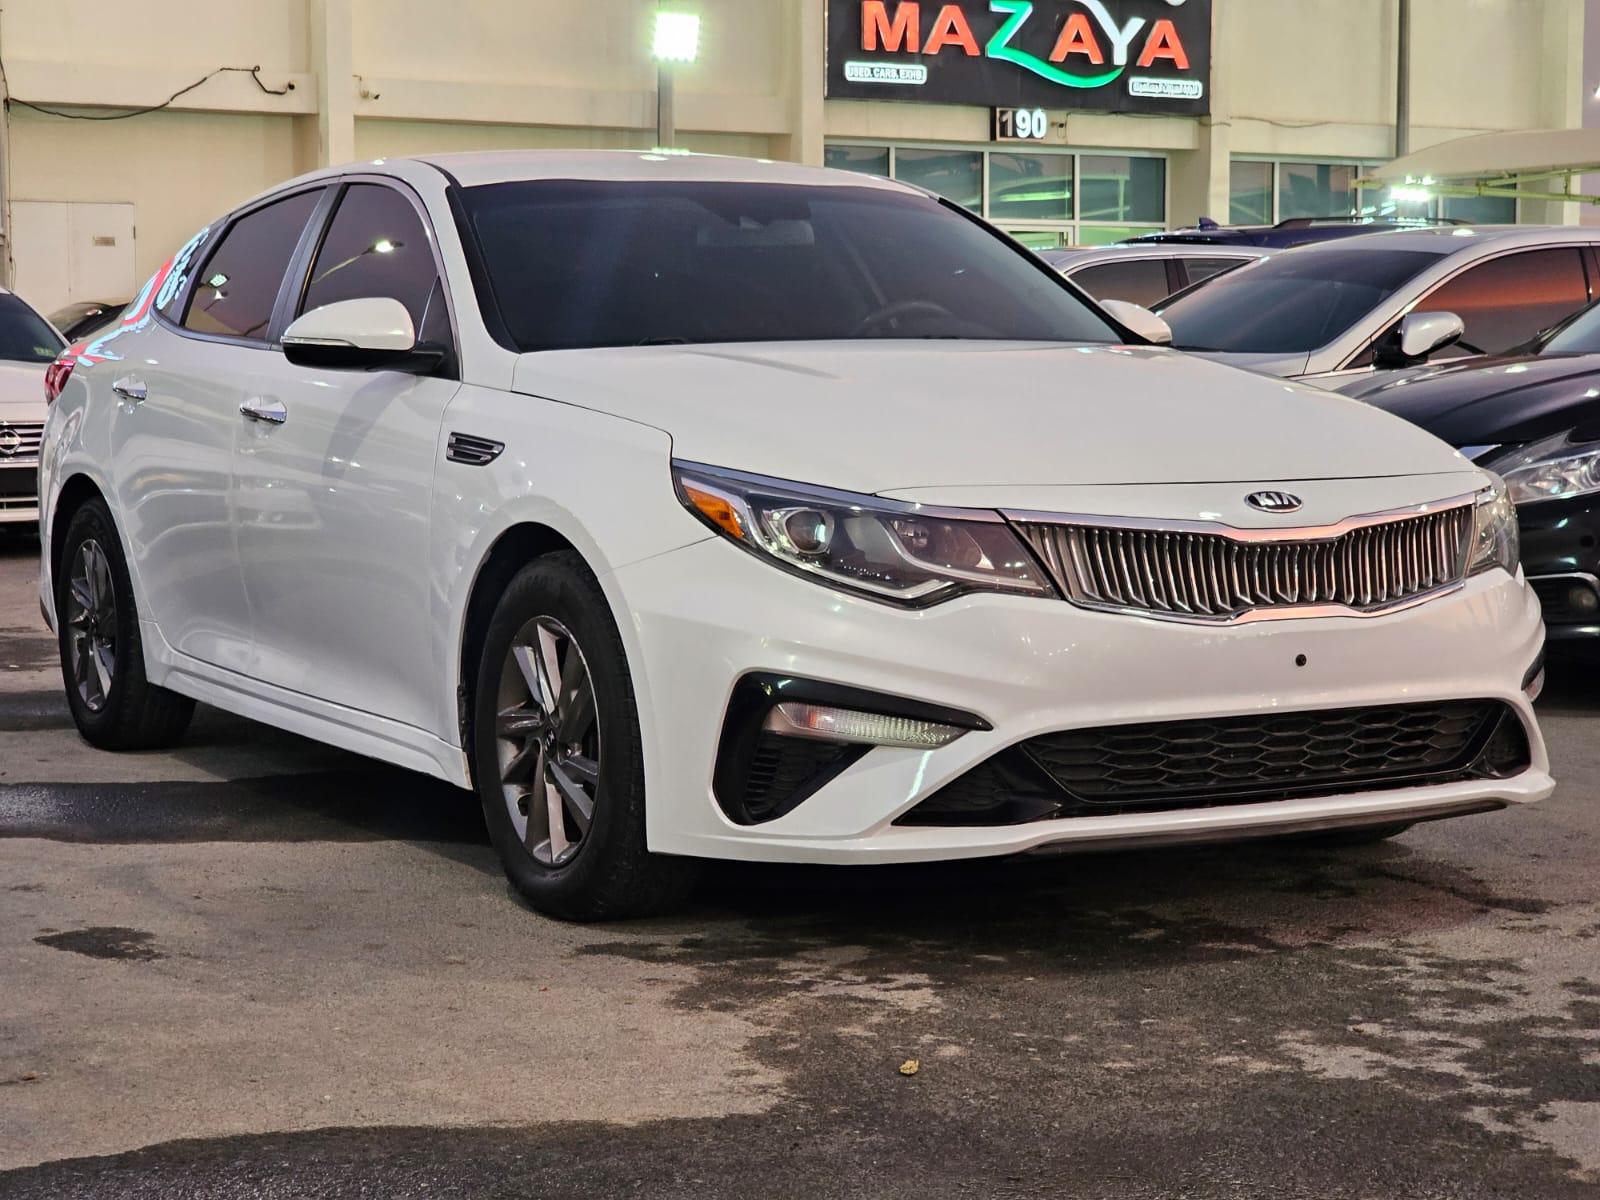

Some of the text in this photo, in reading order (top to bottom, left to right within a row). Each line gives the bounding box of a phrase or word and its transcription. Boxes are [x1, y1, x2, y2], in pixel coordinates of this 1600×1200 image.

[861, 0, 1191, 88] MAZAYA
[1000, 108, 1047, 138] 190
[1252, 492, 1300, 506] KIA
